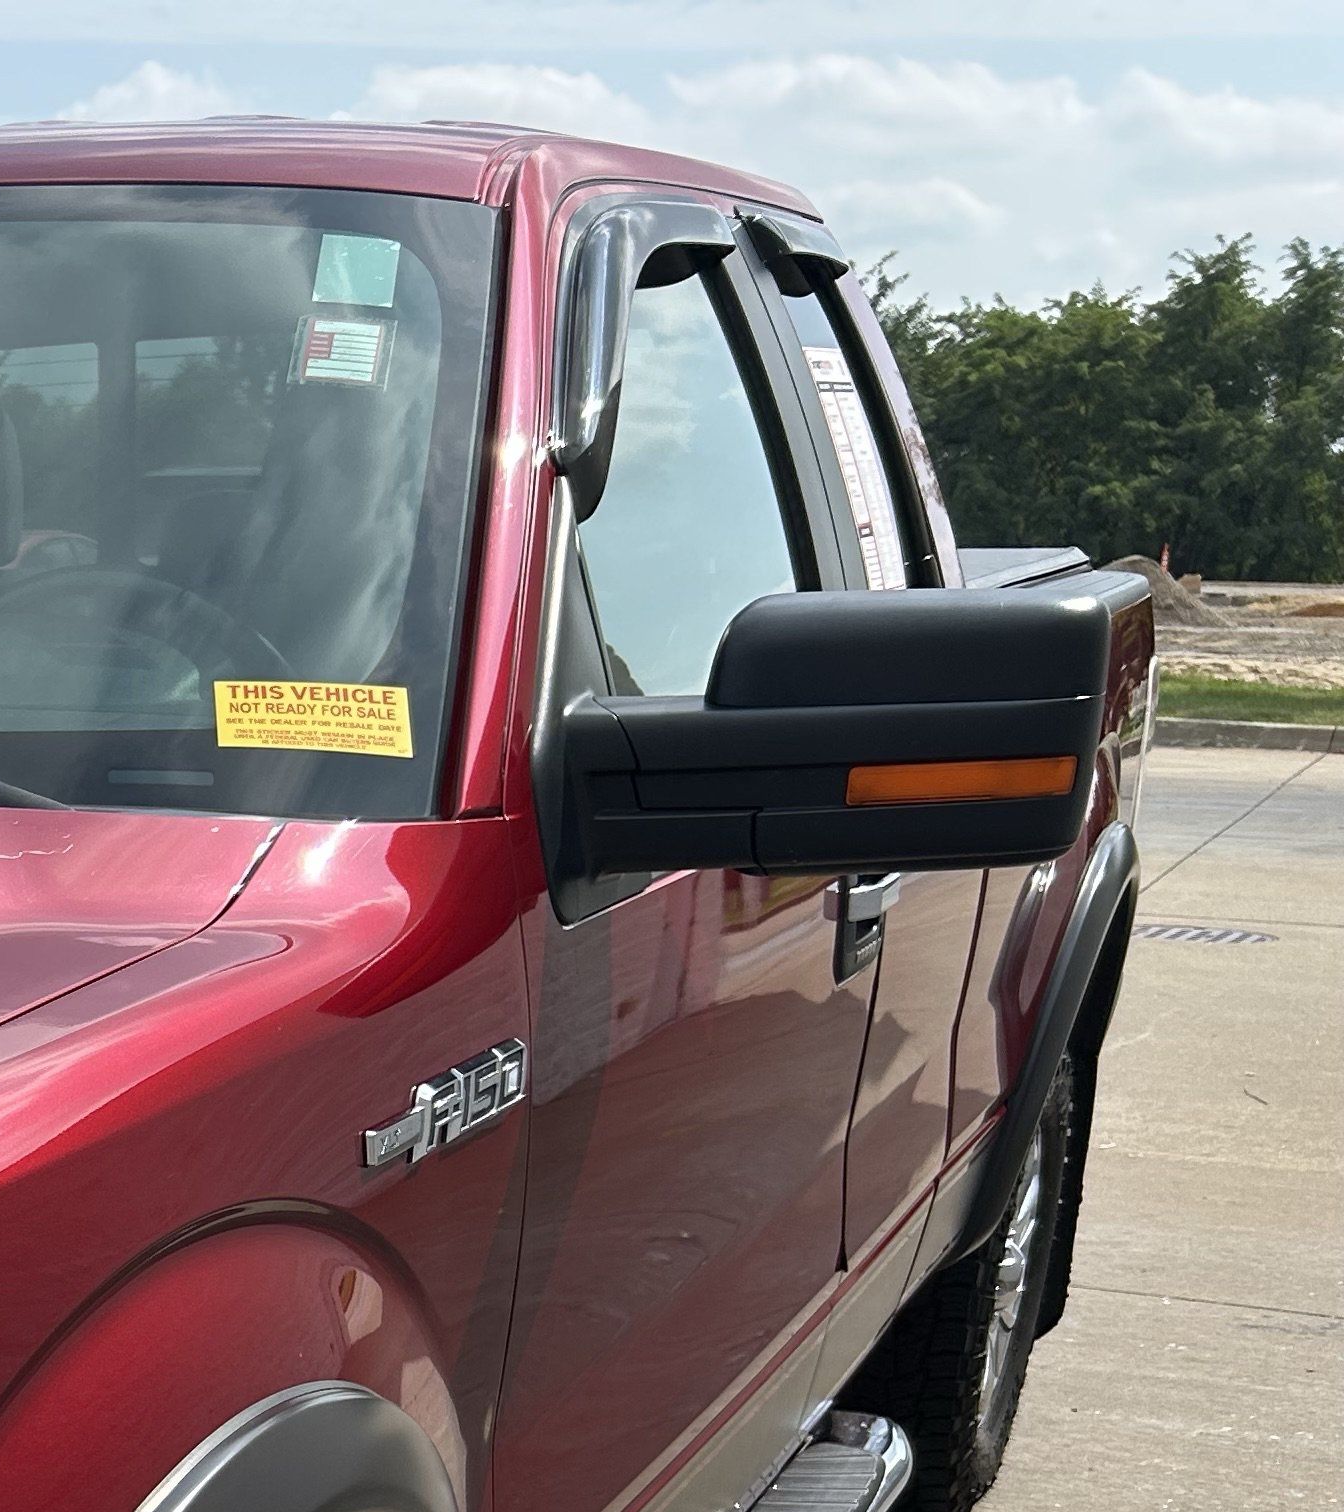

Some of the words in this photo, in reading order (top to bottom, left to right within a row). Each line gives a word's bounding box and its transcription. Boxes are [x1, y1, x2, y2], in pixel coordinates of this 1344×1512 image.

[226, 684, 284, 700] THIS
[290, 686, 397, 706] VEHICLE
[229, 702, 261, 714] NOT
[265, 703, 317, 717] READY
[321, 705, 352, 718] FOR
[356, 707, 397, 721] SALE
[270, 718, 307, 726] DEALER
[335, 721, 374, 731] RESALE
[378, 724, 402, 732] DATE
